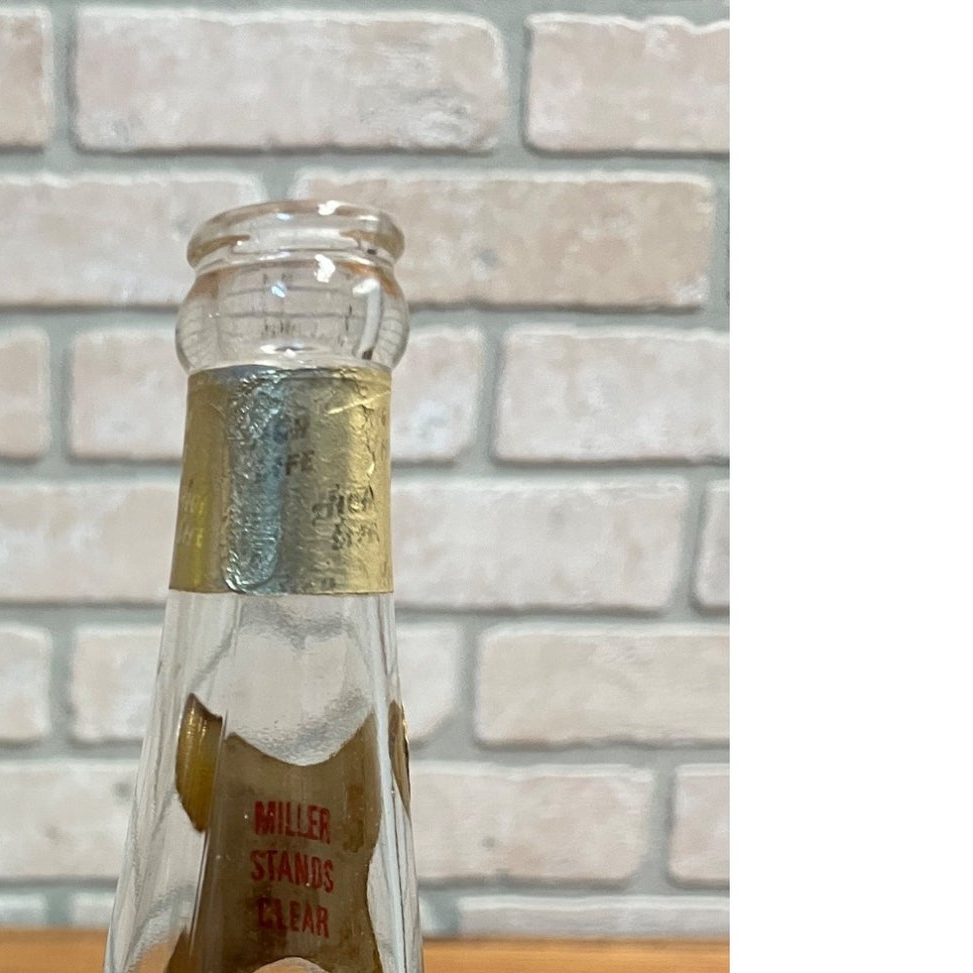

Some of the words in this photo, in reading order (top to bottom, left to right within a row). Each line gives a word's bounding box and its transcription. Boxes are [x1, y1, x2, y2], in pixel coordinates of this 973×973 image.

[254, 801, 331, 844] MILLER
[250, 849, 334, 893] STANDS
[257, 896, 330, 938] CLEAR
